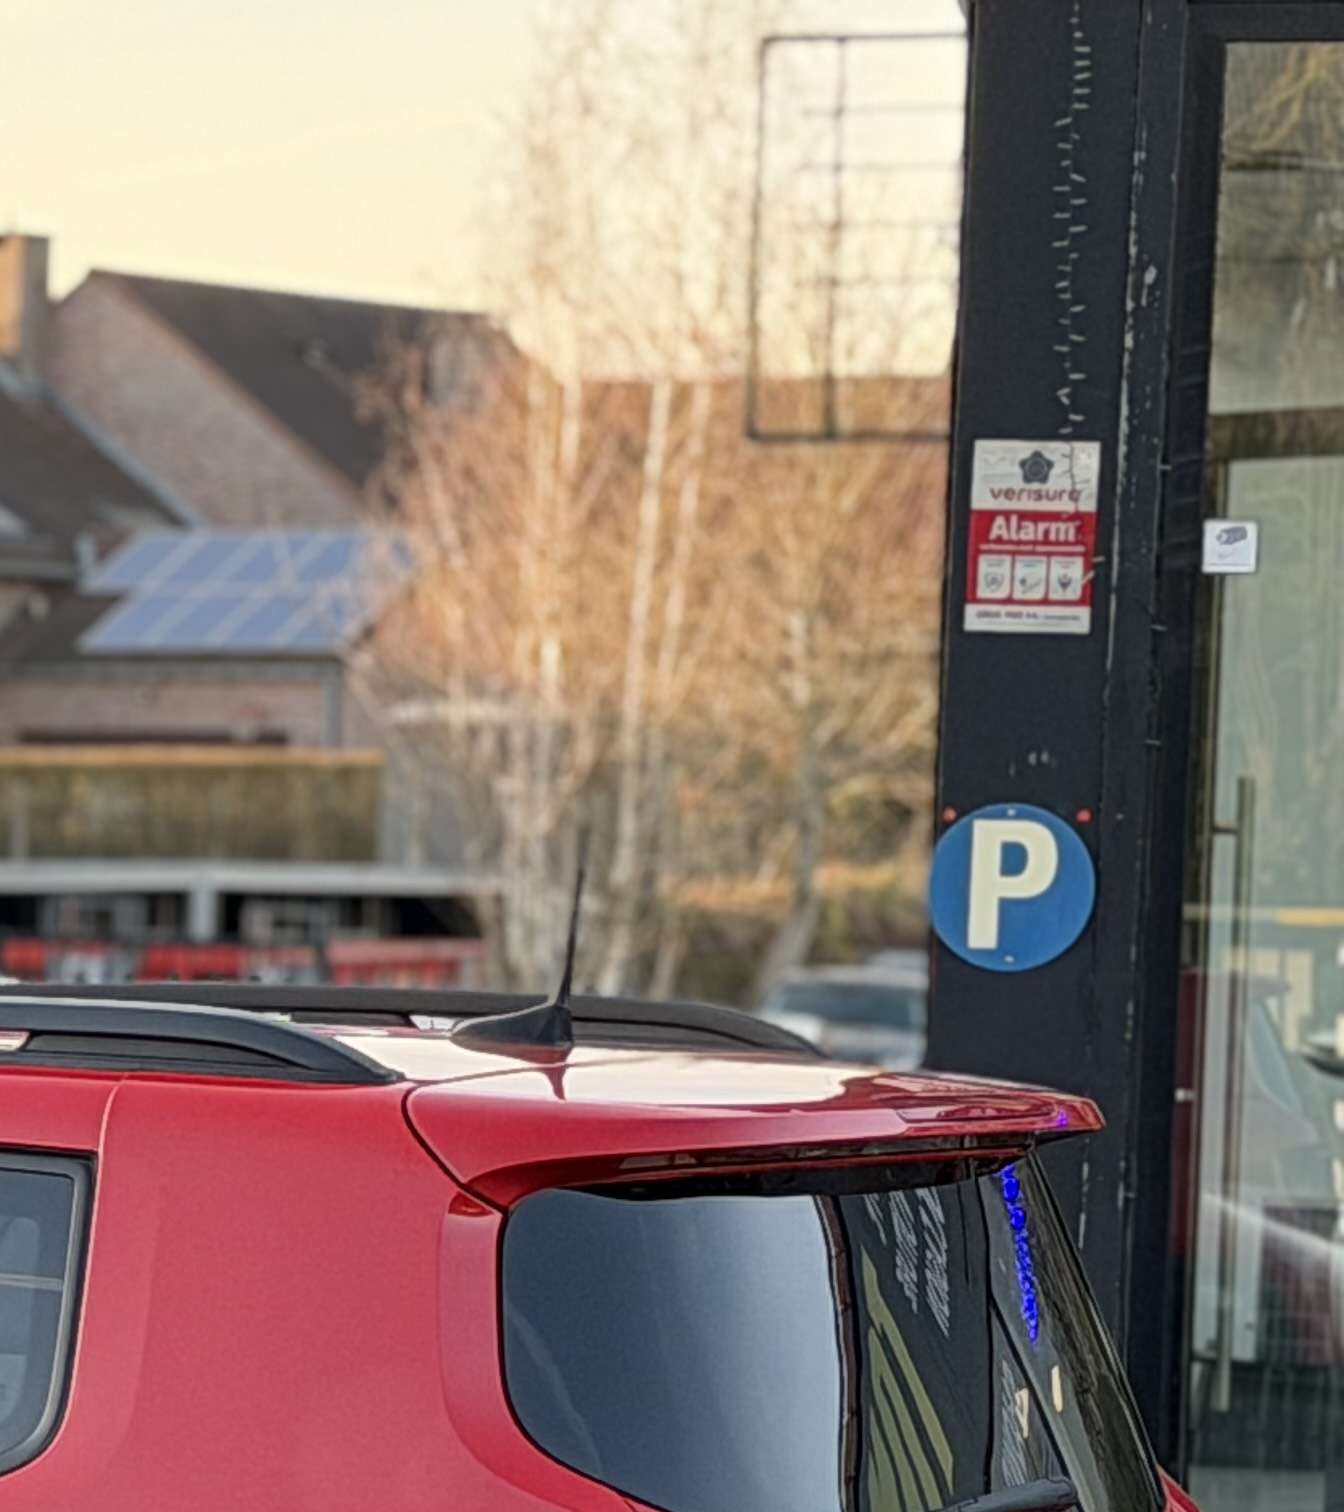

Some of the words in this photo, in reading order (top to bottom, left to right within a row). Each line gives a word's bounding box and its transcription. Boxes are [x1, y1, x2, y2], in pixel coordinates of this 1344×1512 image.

[989, 486, 1083, 503] verisure
[988, 513, 1078, 543] Alarm
[967, 819, 1059, 949] P
